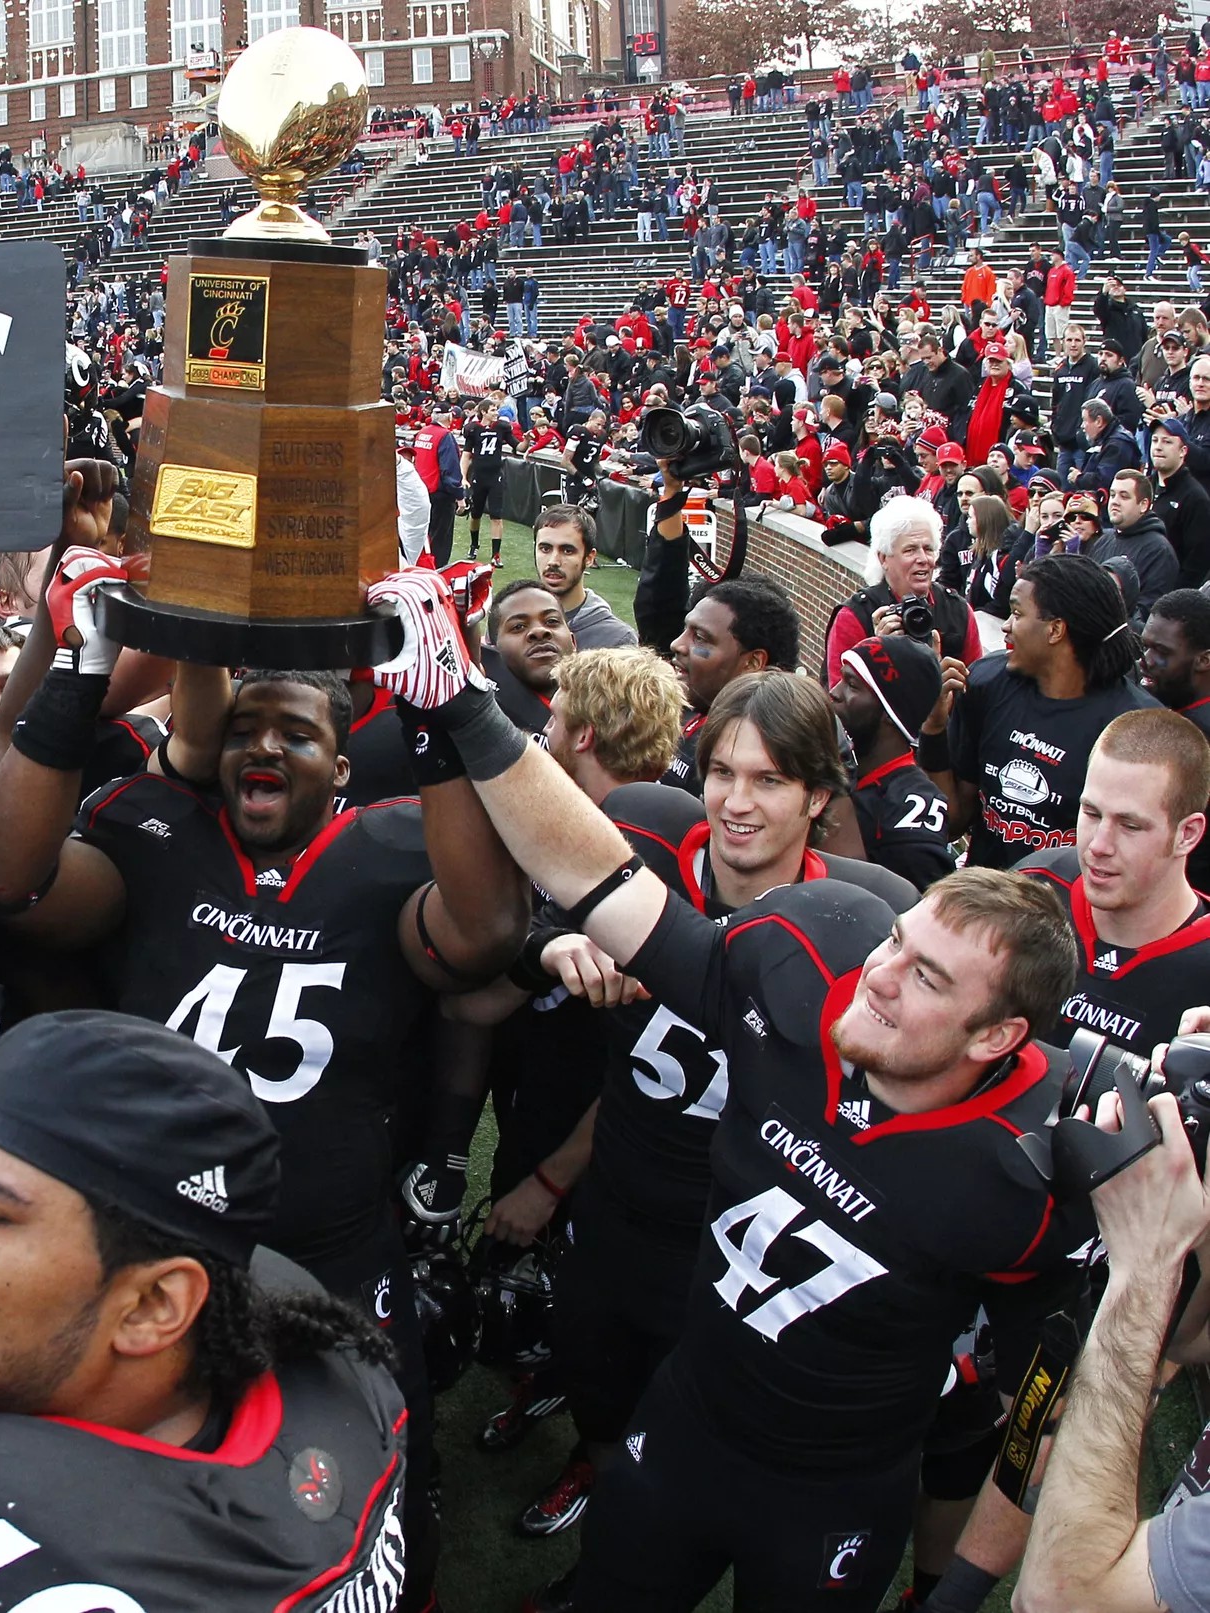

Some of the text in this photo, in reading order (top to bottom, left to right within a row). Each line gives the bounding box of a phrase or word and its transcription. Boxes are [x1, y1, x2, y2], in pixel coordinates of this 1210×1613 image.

[633, 33, 657, 53] 25
[194, 280, 262, 291] UNIVERSITY OF
[202, 290, 253, 300] CINCINNATI
[673, 288, 688, 306] 12
[191, 368, 258, 383] 2009 CHAMPIONS
[271, 441, 344, 467] RUTGERS
[480, 437, 498, 455] 14
[583, 447, 598, 463] 3
[176, 479, 239, 500] BIG
[164, 500, 251, 521] EAST
[175, 523, 250, 539] CONFERENCE
[267, 515, 345, 540] SYRACUSE
[264, 554, 345, 577] WEST VIRGINIA
[693, 553, 720, 580] Canon
[445, 640, 458, 675] adidas
[1010, 730, 1066, 762] CINCINNATI
[985, 763, 1062, 805] 20 11
[147, 818, 170, 831] BIG
[894, 794, 948, 833] 25
[990, 796, 1050, 828] FOOTBALL
[254, 878, 286, 888] adidas
[192, 902, 320, 951] CINCINNATI
[745, 1014, 768, 1039] EAST
[750, 1009, 765, 1028] BIG
[164, 962, 347, 1103] 45
[836, 1103, 871, 1131] adidas
[760, 1119, 876, 1222] CINCINNATI
[176, 1181, 228, 1213] adidas
[426, 1179, 438, 1206] adidas
[710, 1186, 889, 1342] 47
[1017, 1367, 1051, 1430] Nikon
[626, 1440, 642, 1462] adidas
